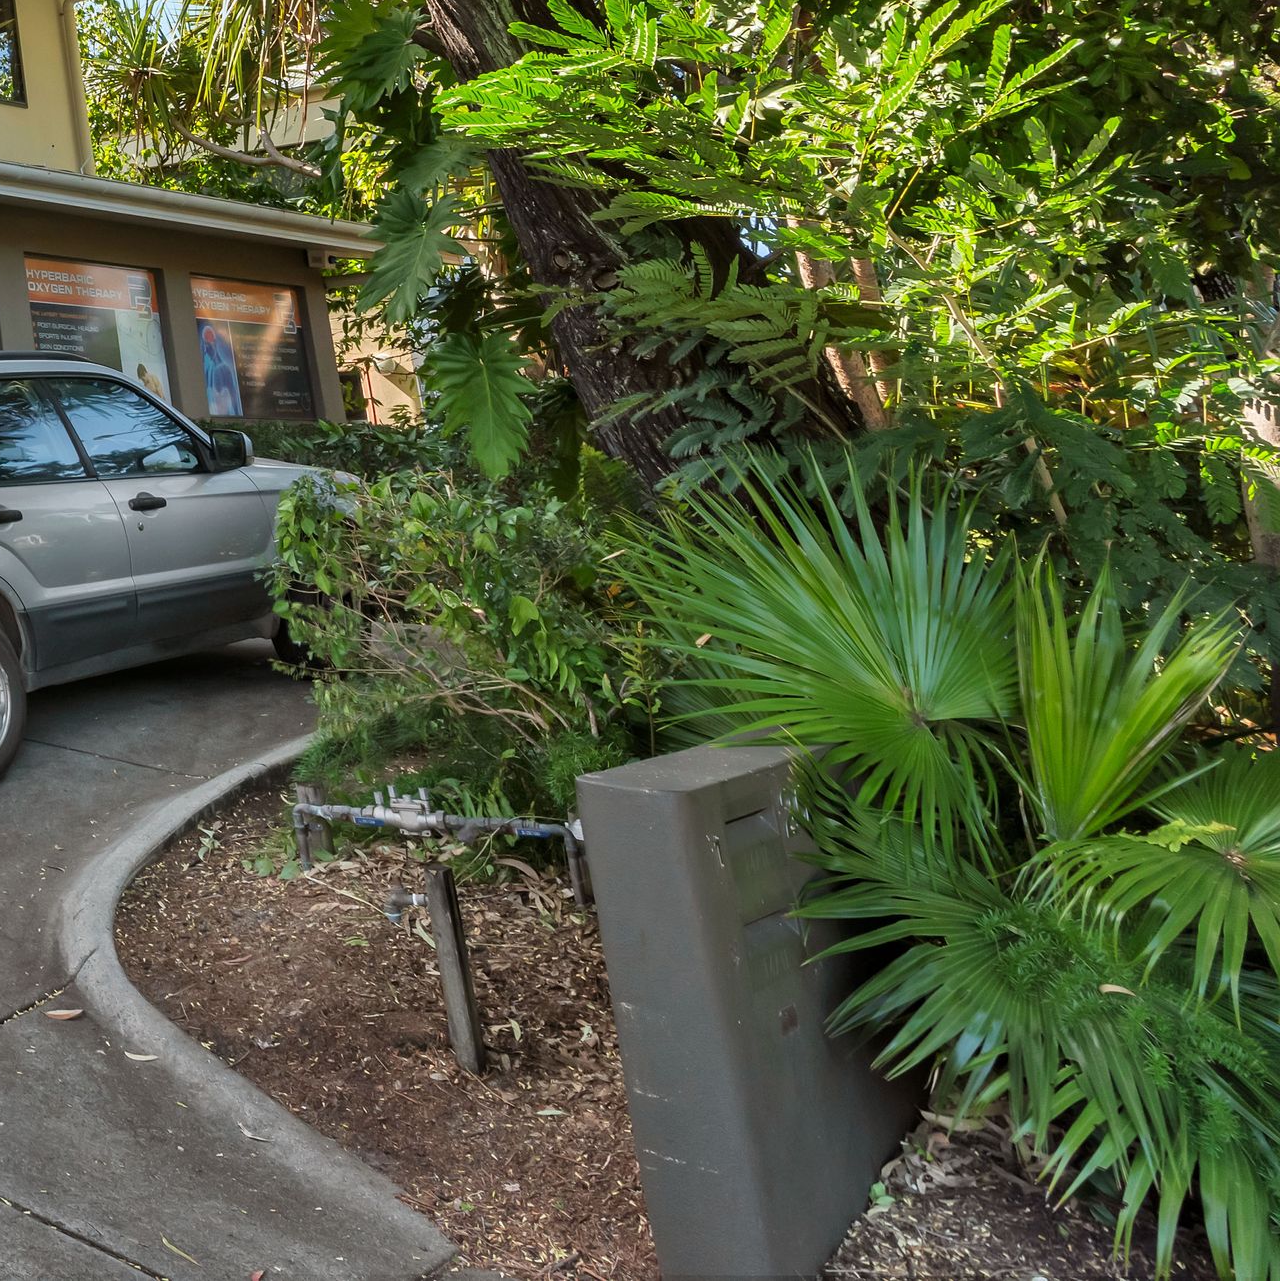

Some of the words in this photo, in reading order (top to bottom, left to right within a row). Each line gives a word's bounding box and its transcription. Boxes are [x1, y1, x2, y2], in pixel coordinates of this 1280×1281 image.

[25, 269, 95, 285] HYPERBARIC
[27, 281, 73, 295] OXYGEN
[76, 286, 122, 299] THERAPY
